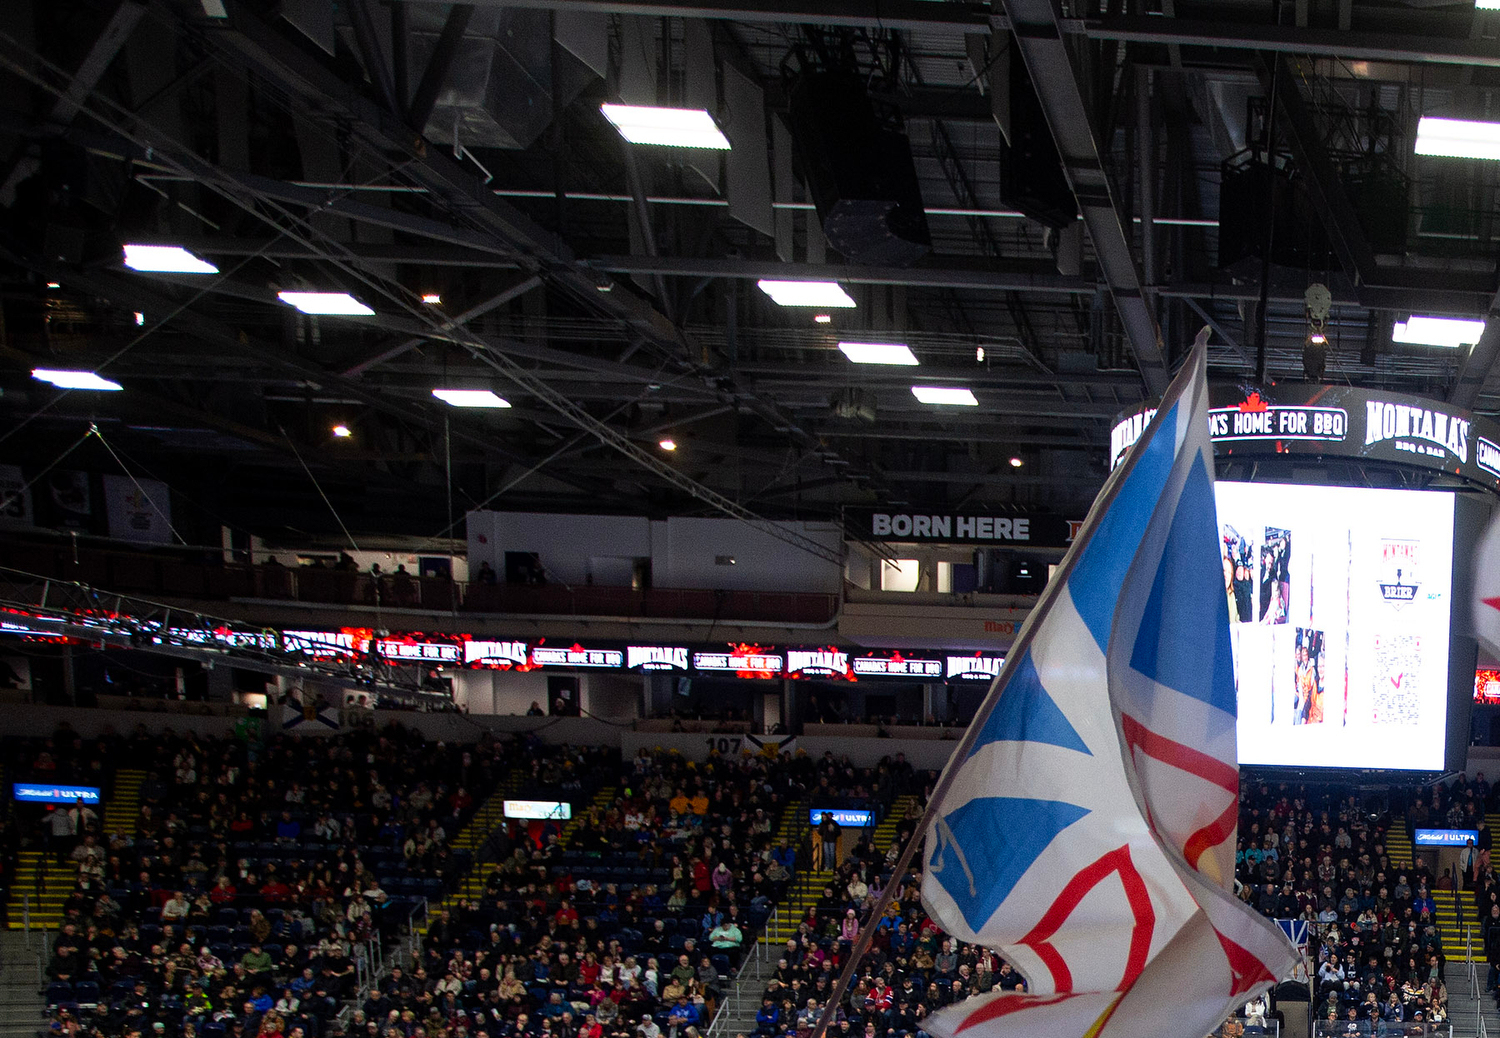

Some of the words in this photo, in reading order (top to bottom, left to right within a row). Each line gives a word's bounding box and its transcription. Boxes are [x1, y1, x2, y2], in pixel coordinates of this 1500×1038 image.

[1234, 411, 1273, 434] HOME
[1280, 411, 1308, 434] FOR
[1313, 411, 1343, 436] BBQ
[1365, 400, 1470, 464] MONTANA'S
[872, 513, 950, 538] BORN
[957, 516, 1030, 540] HERE
[909, 662, 923, 673] FOR
[706, 737, 742, 754] 107
[61, 790, 98, 799] ULTRA
[1449, 834, 1476, 842] ULTRA
